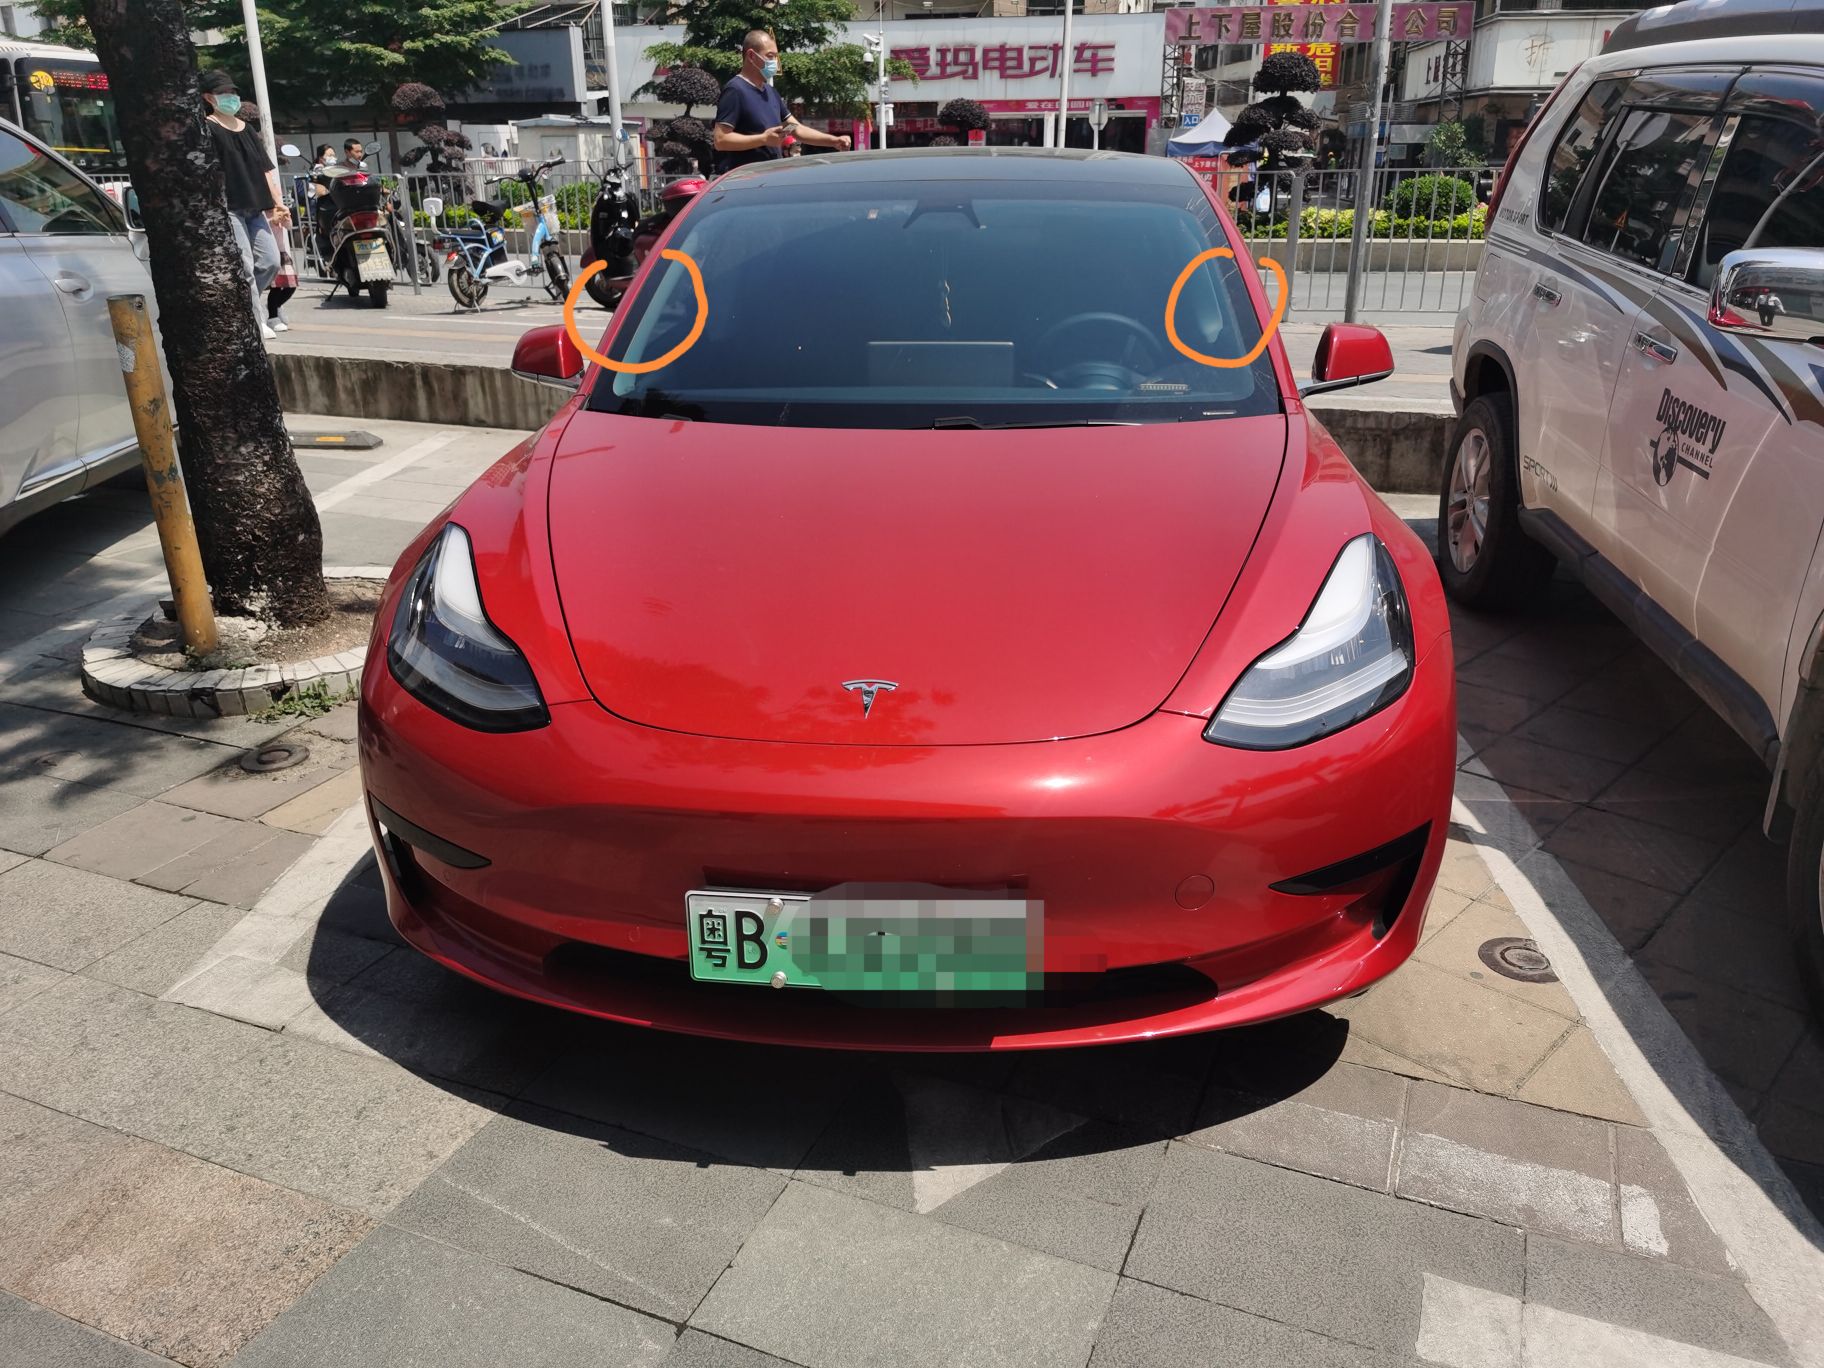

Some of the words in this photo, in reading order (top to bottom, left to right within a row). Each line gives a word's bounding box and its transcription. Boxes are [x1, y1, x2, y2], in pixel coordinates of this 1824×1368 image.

[890, 41, 1115, 81] 爱玛电动车
[1184, 116, 1199, 125] 入口
[1681, 442, 1713, 468] CHANNEL
